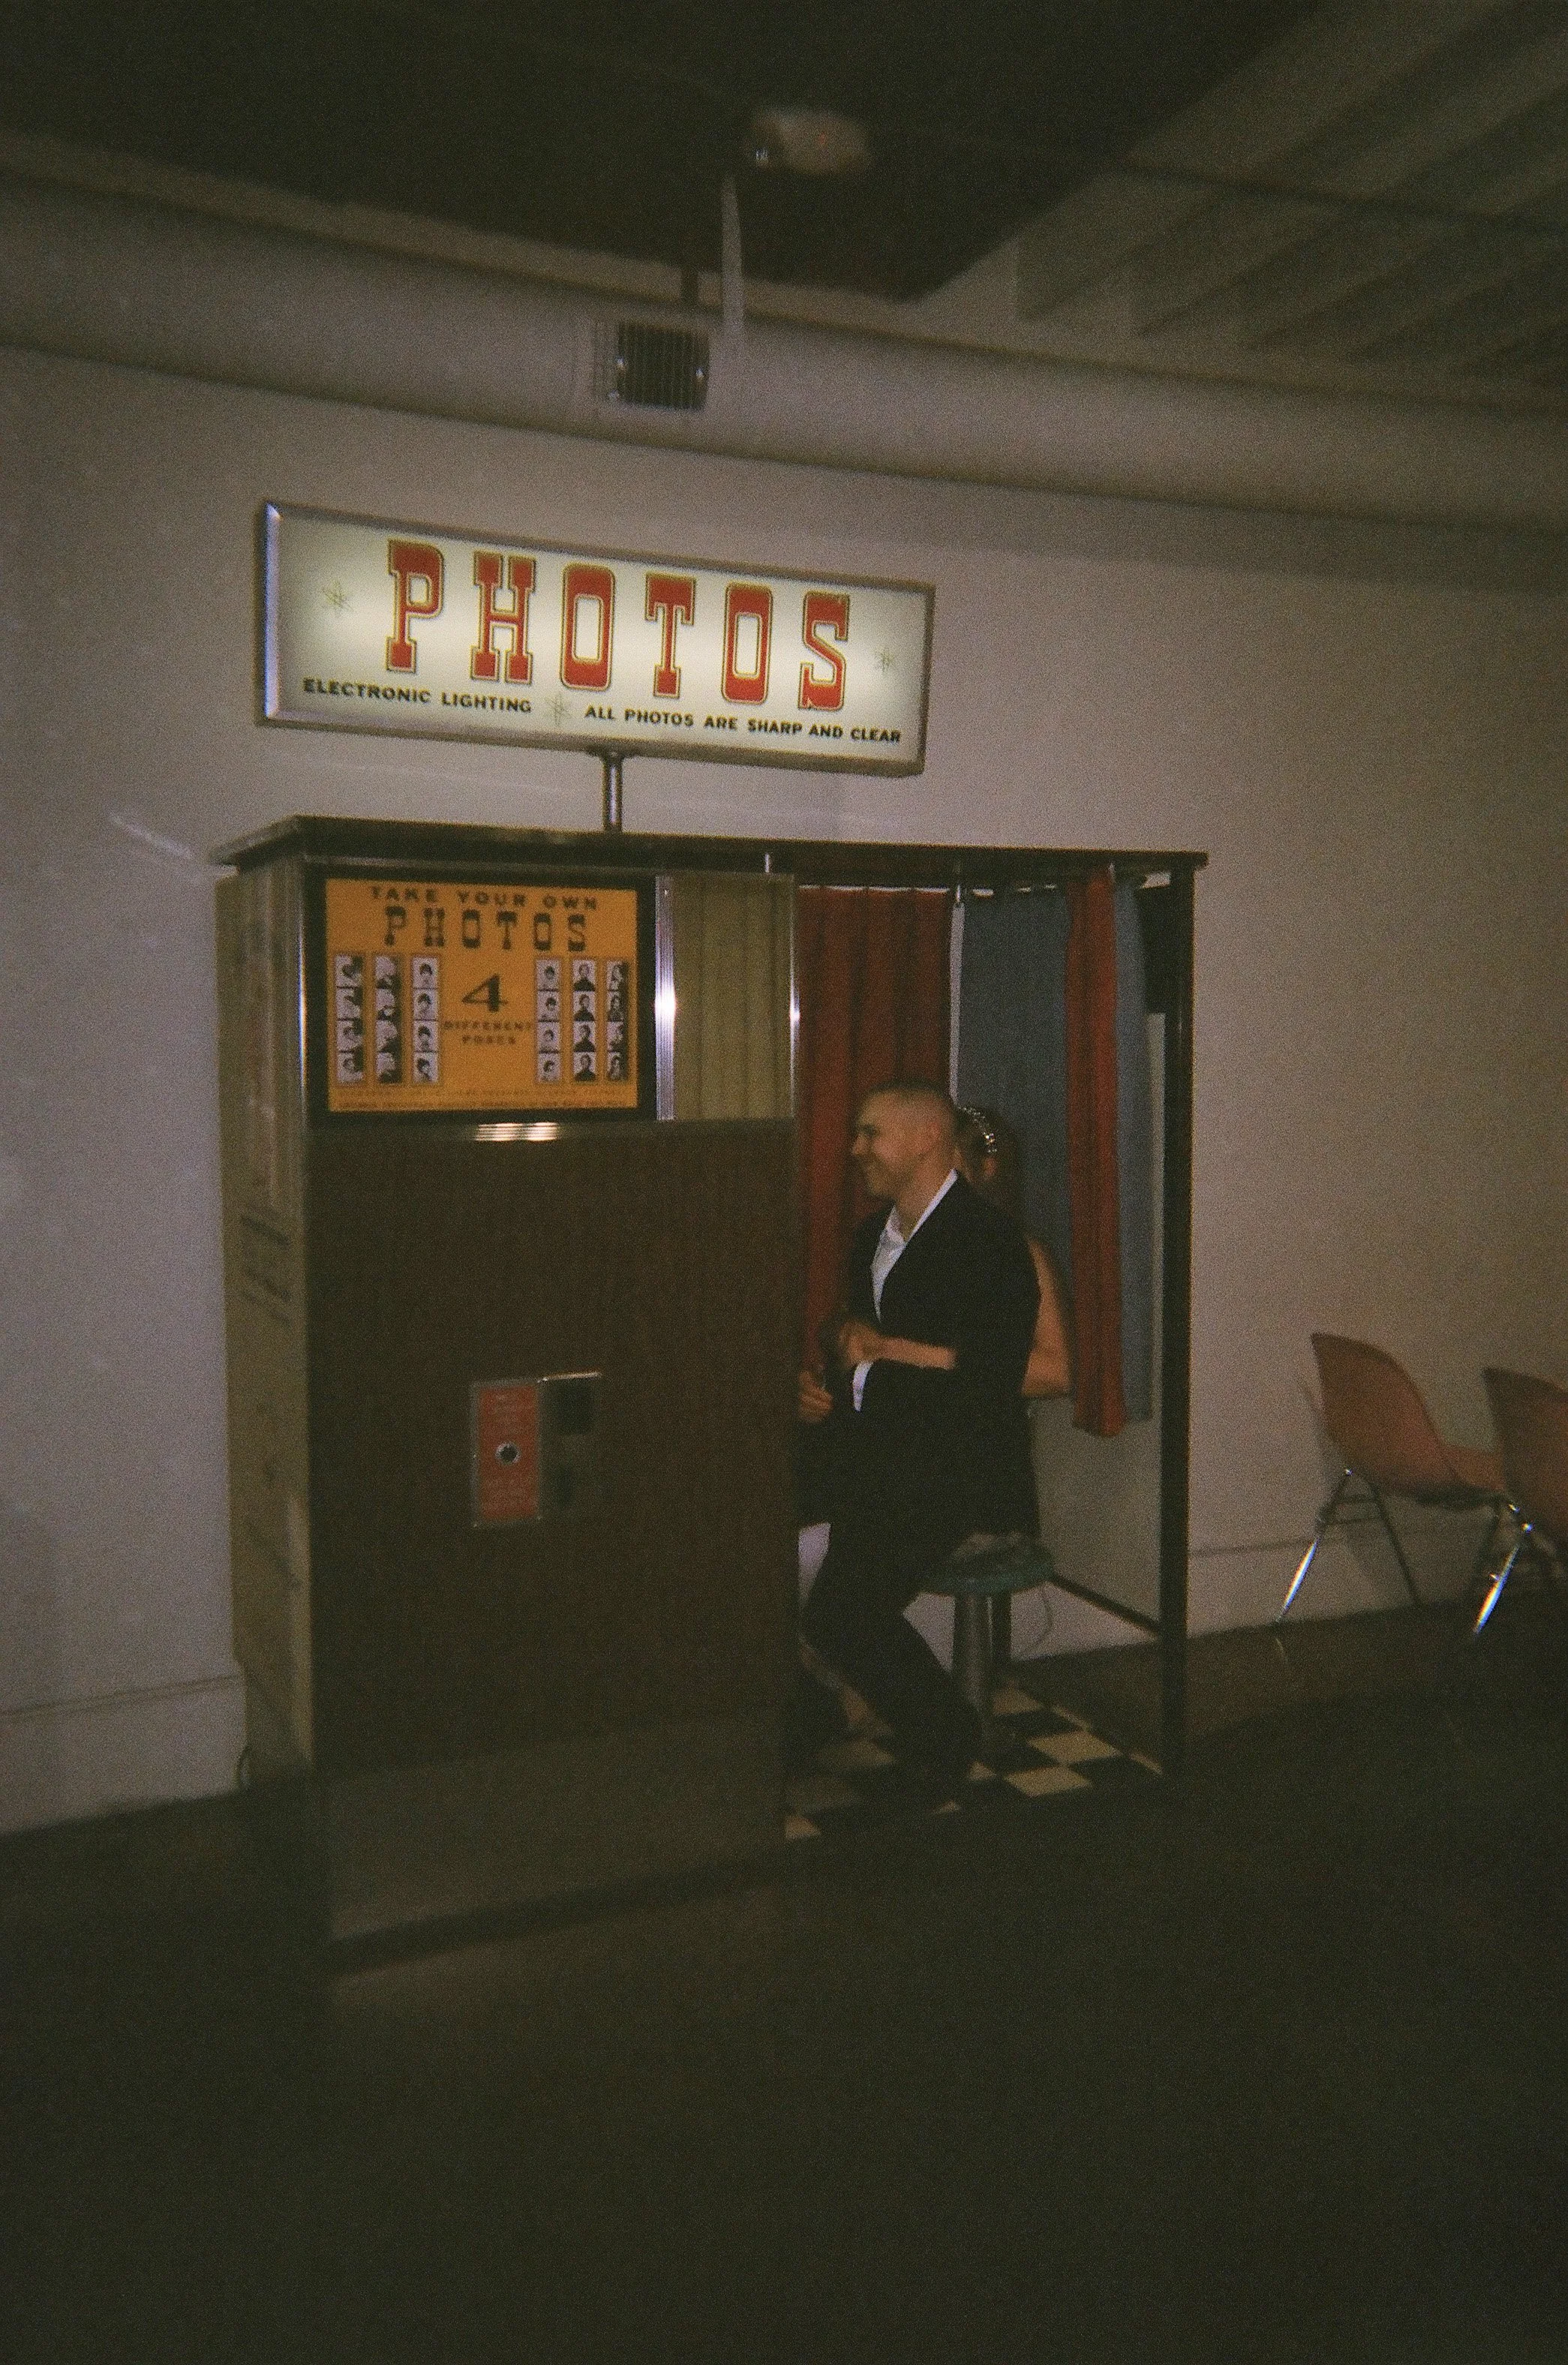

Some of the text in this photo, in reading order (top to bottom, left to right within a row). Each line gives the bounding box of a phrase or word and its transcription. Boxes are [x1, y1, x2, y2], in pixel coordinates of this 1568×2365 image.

[386, 539, 851, 711] PHOTOS
[303, 678, 901, 744] ELECTRONIC LIGHTING ALL PHOTOS ARE SHARP AND CLEAR
[372, 887, 597, 910] TAKE YOUR OWN
[384, 906, 586, 951] PHOTOS
[461, 974, 508, 1012] 4
